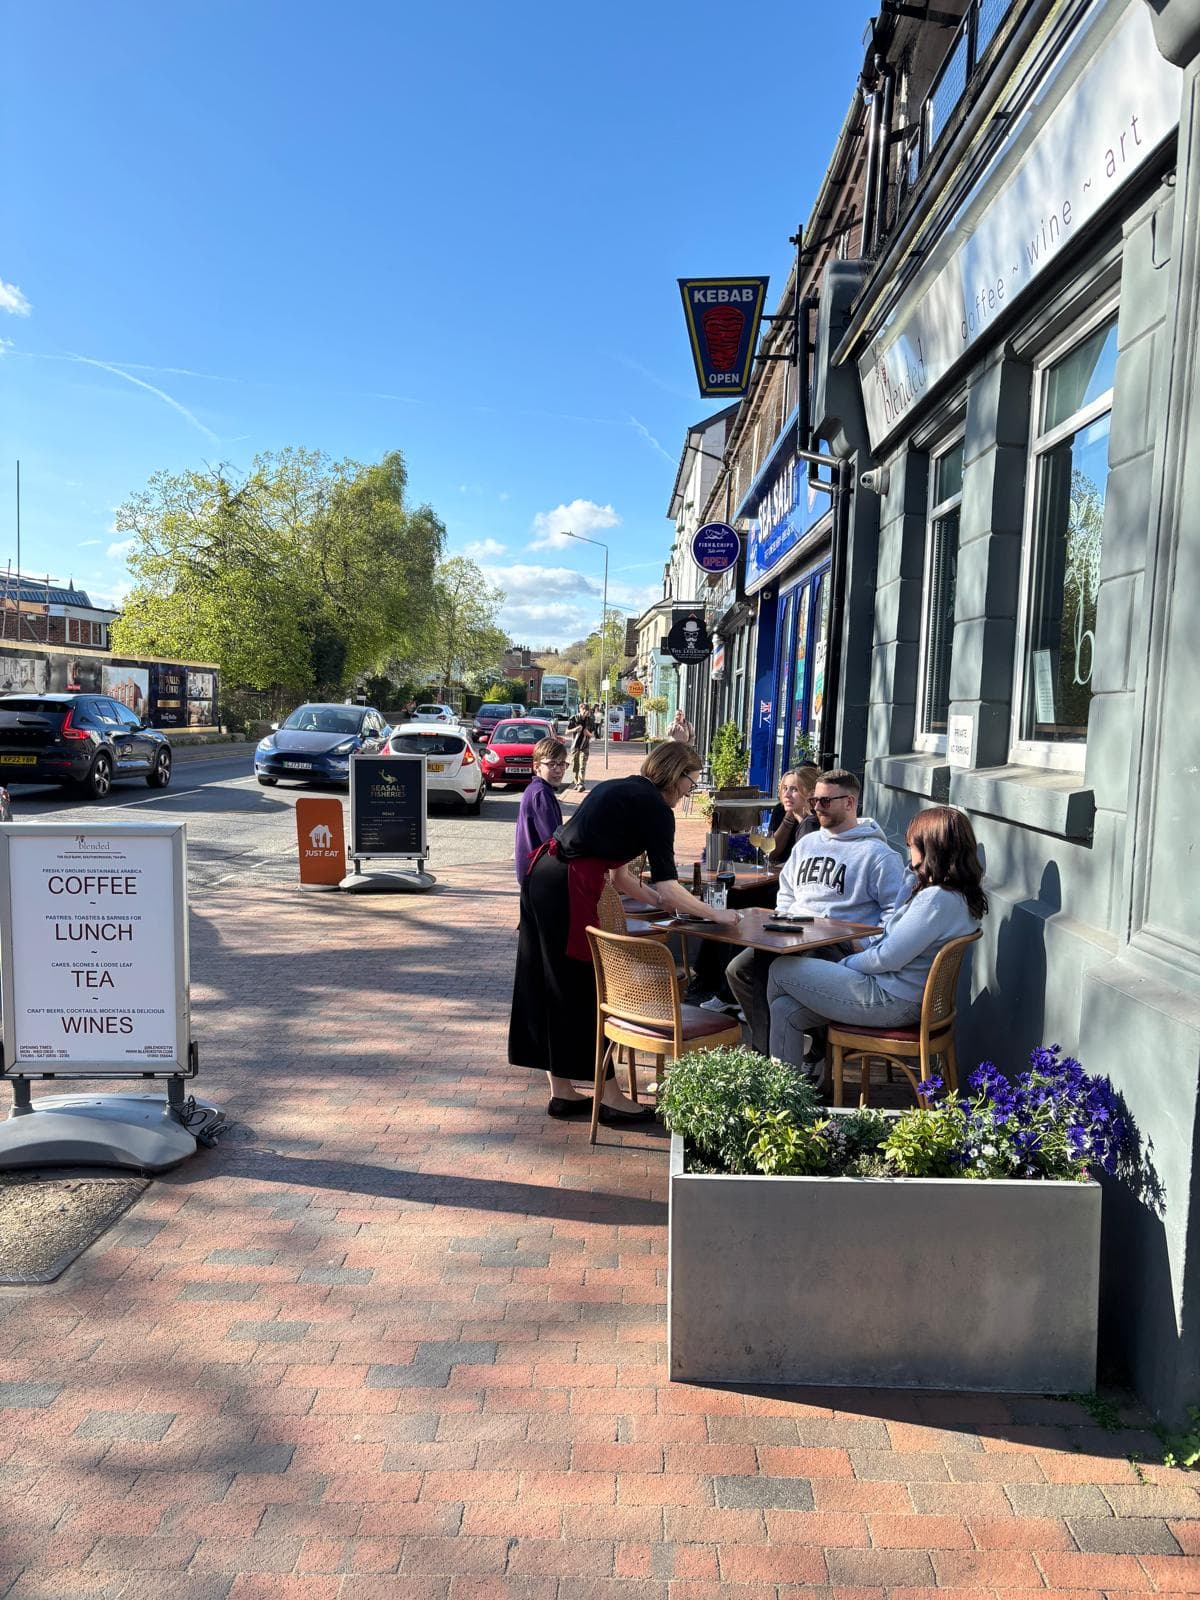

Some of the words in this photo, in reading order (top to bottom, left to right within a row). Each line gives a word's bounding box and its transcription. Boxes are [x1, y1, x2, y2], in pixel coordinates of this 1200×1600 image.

[961, 278, 1005, 341] coffee
[1026, 199, 1073, 265] wine
[1105, 115, 1143, 179] art
[693, 289, 754, 303] KEBAB
[708, 373, 740, 384] OPEN
[703, 557, 728, 566] OPEN
[78, 841, 111, 850] blended
[796, 856, 848, 896] HERA
[48, 876, 137, 895] COFFEE
[55, 923, 133, 941] LUNCH
[70, 970, 115, 988] TEA
[61, 1016, 134, 1034] WINES
